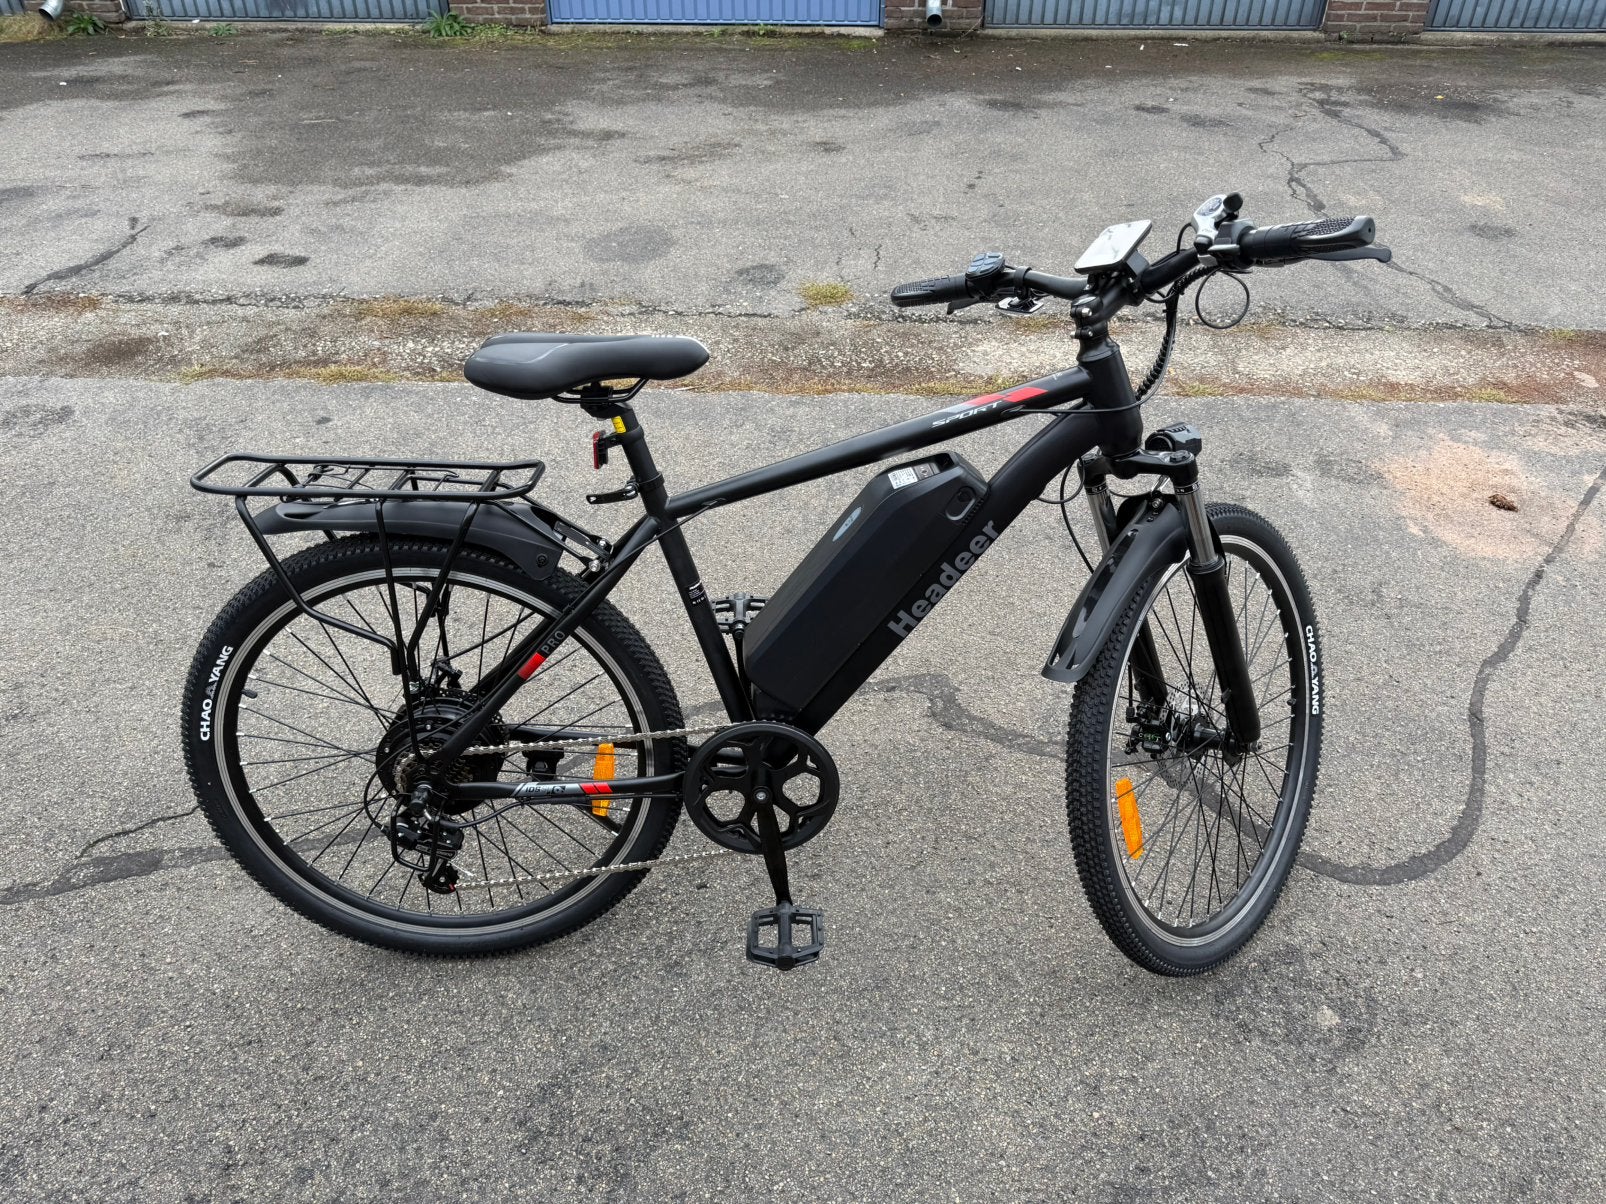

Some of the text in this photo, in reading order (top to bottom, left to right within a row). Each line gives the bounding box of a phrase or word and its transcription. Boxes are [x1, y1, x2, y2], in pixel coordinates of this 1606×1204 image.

[930, 400, 1002, 429] SPORT
[887, 520, 999, 638] Headeer
[540, 630, 566, 655] PRO
[1305, 625, 1320, 715] CHAO YANG
[200, 645, 234, 741] CHAO YANG
